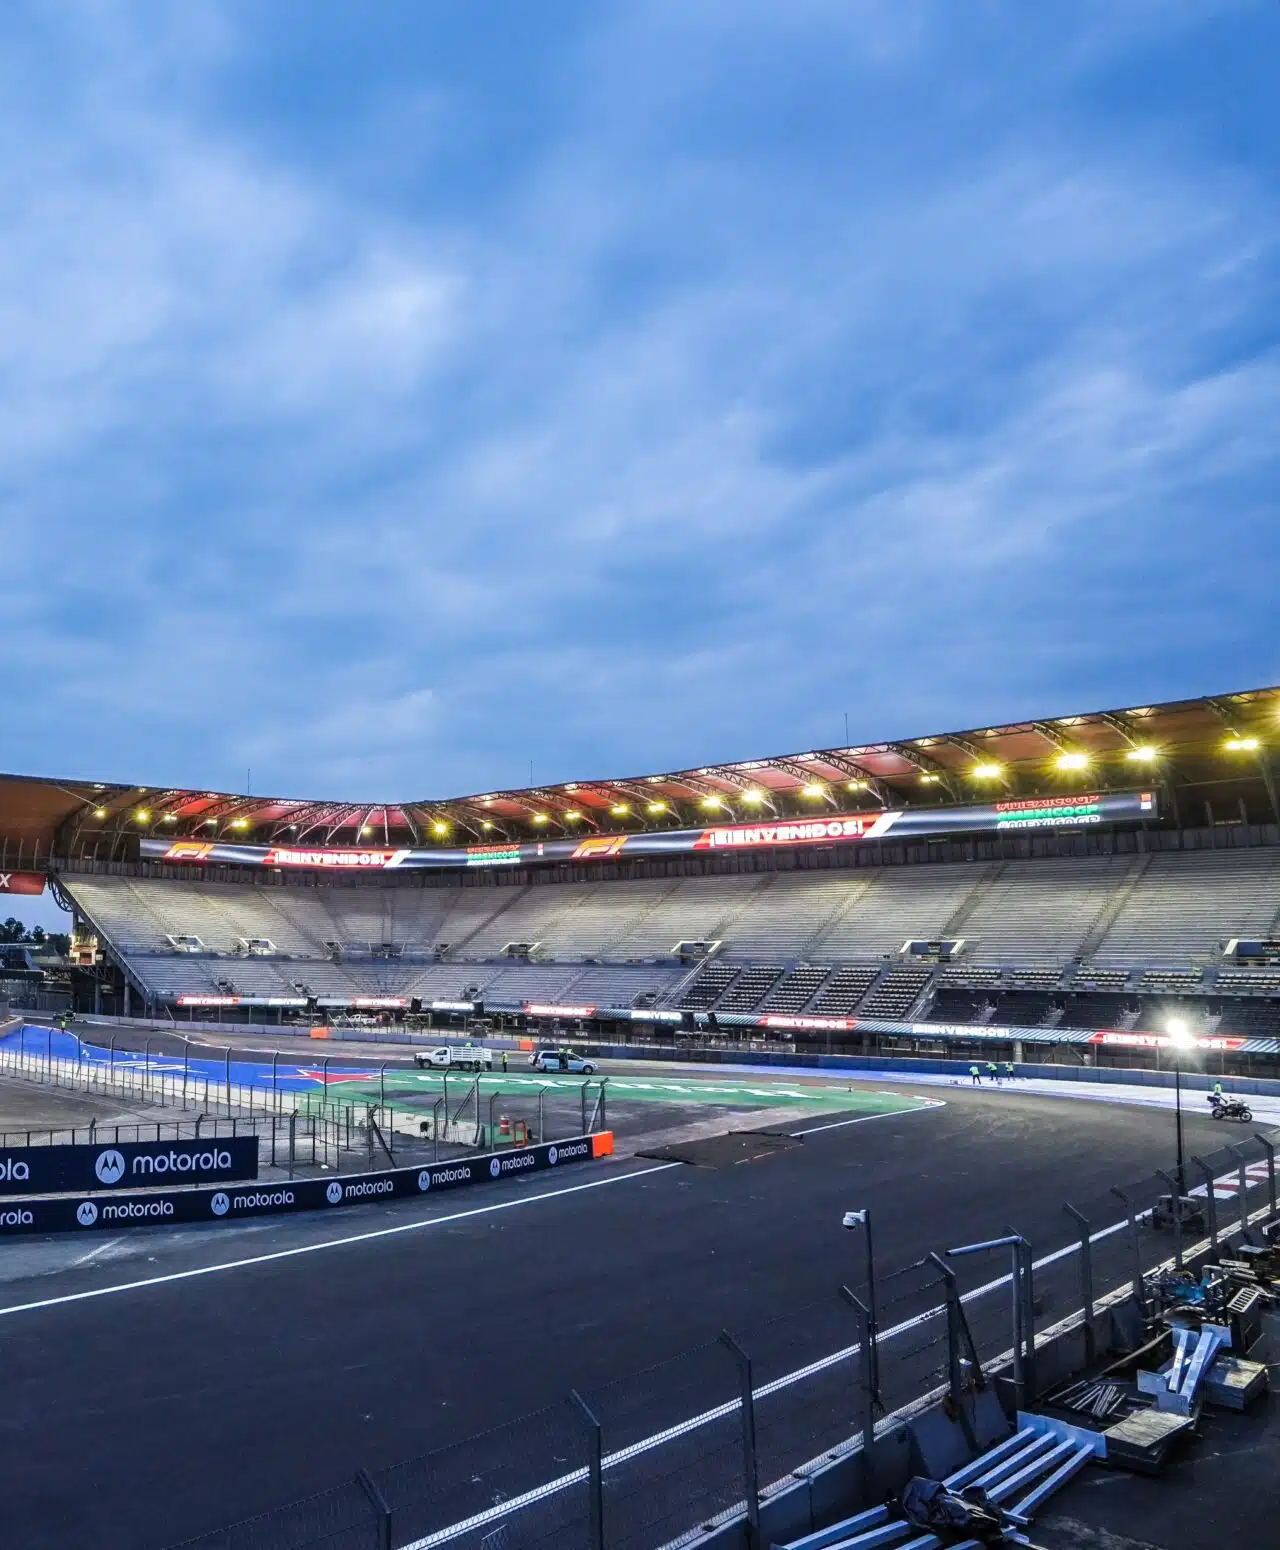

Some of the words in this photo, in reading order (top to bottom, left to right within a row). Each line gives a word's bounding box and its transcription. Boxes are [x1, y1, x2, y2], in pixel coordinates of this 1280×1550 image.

[558, 1143, 588, 1159] motorola
[133, 1149, 231, 1174] motorola
[501, 1154, 535, 1171] motorola
[432, 1167, 470, 1185] motorola
[345, 1179, 393, 1198] motorola
[233, 1190, 295, 1209] motorola
[102, 1200, 174, 1219] motorola
